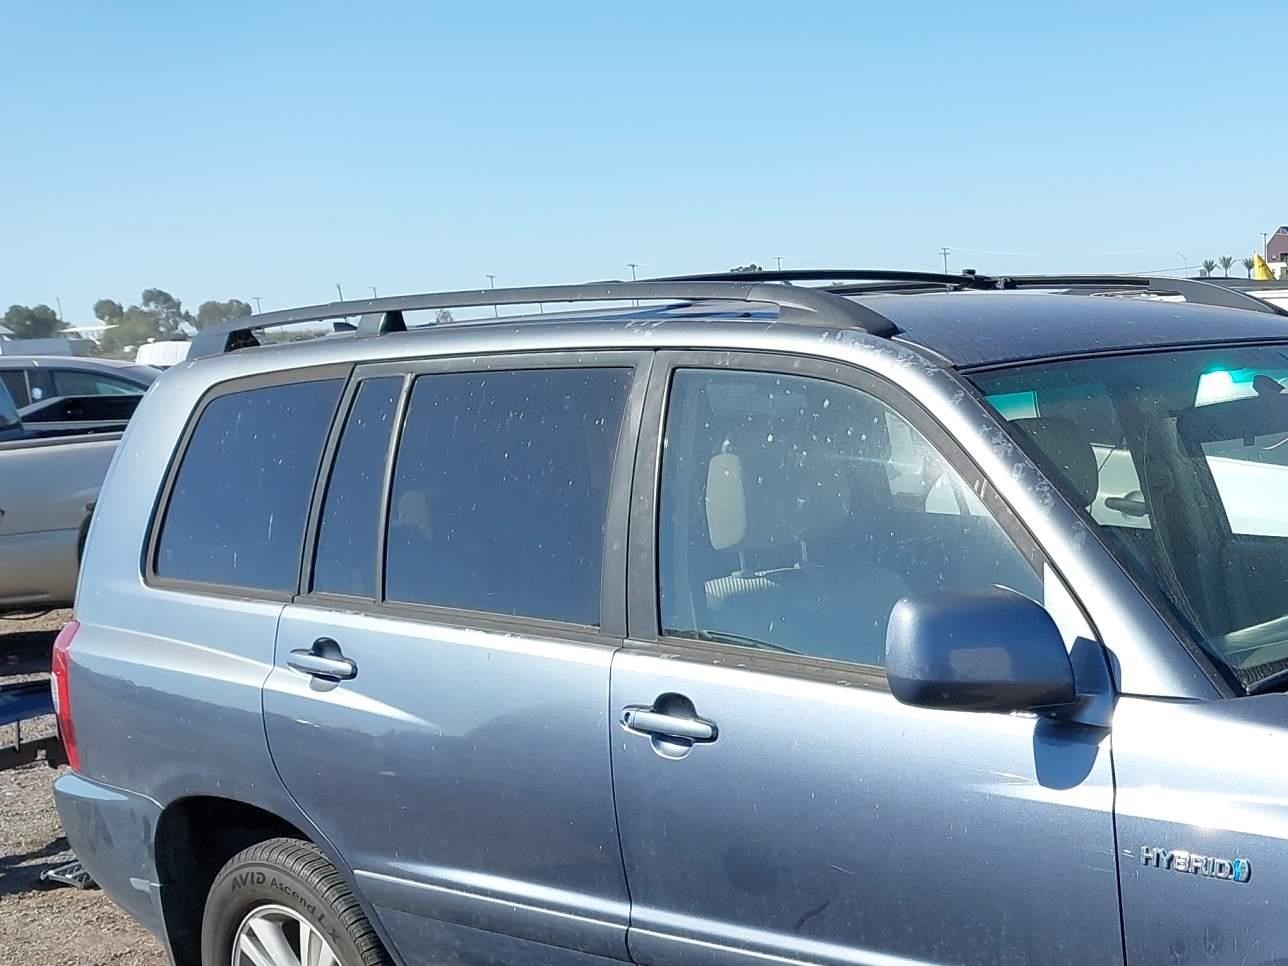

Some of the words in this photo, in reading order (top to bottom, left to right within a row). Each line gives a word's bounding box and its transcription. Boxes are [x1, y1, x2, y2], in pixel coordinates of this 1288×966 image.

[1140, 845, 1233, 880] HYBRID
[231, 871, 267, 893] AVID
[269, 877, 317, 915] Ascend
